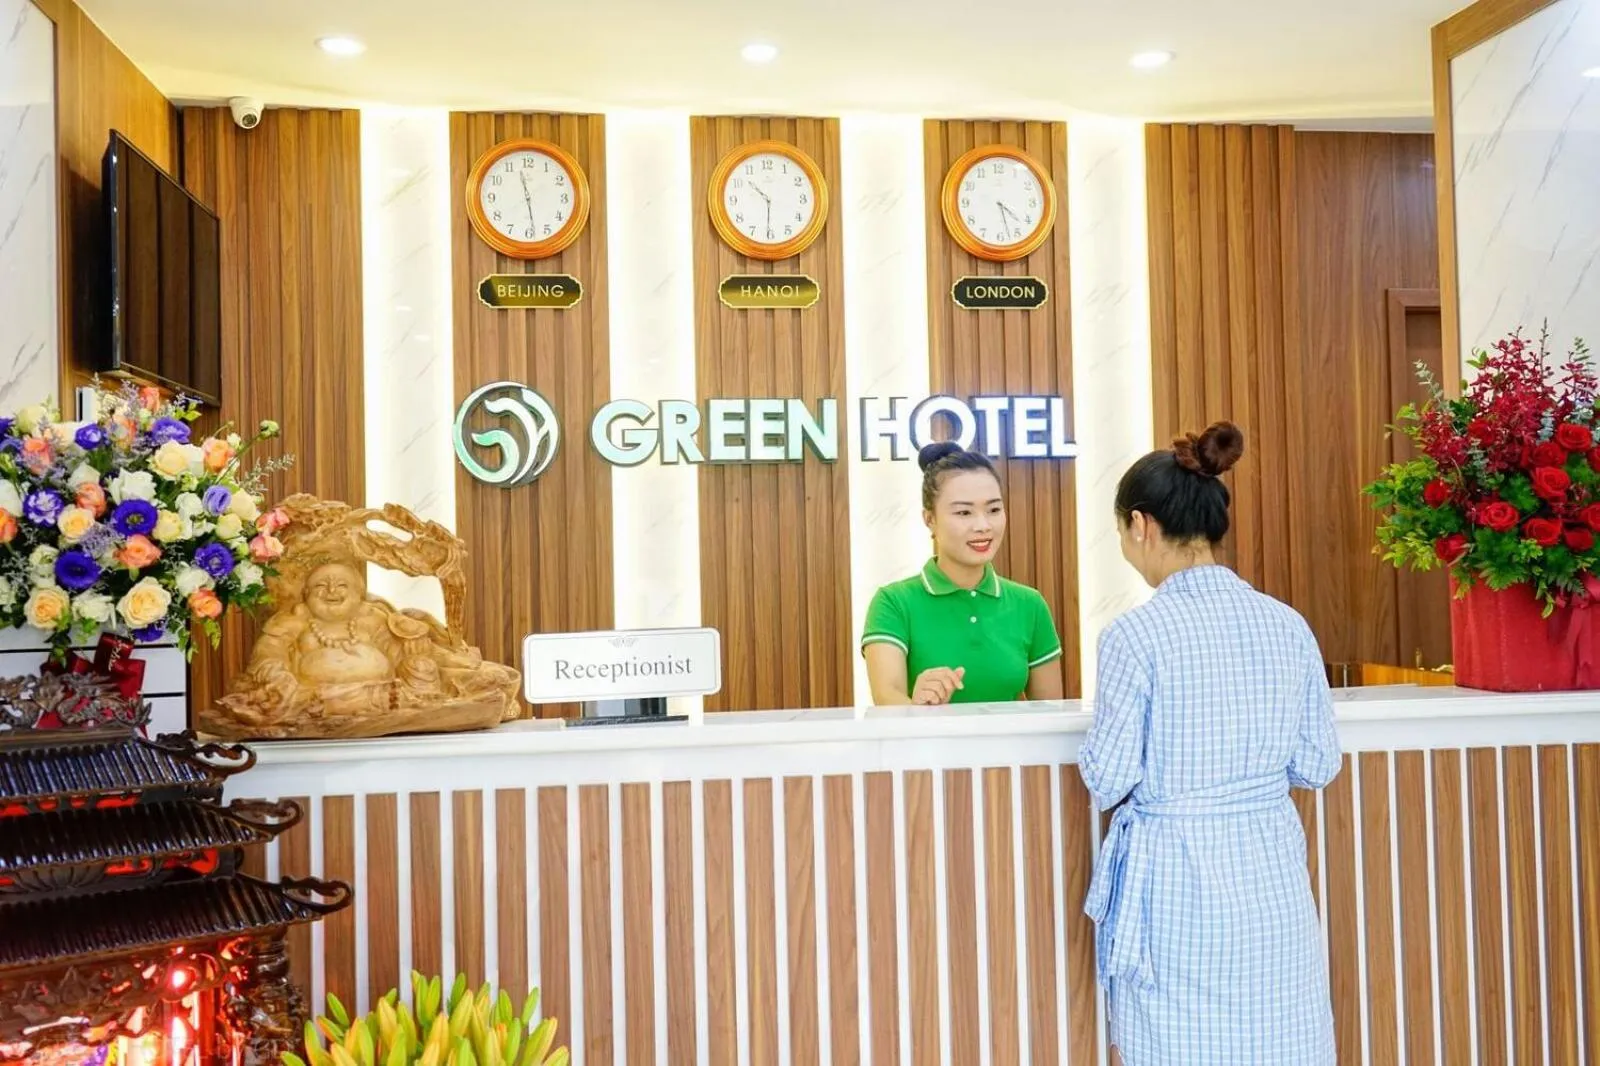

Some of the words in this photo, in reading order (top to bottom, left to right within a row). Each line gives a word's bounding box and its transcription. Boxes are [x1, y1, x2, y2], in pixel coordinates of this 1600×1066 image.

[504, 162, 513, 172] 11
[522, 158, 534, 168] 12
[544, 162, 548, 172] 1
[762, 160, 773, 170] 12
[745, 165, 753, 174] 11
[782, 164, 787, 174] 1
[977, 168, 986, 178] 11
[993, 164, 1004, 174] 12
[492, 176, 502, 186] 10
[555, 176, 564, 186] 2
[733, 178, 743, 188] 10
[794, 177, 802, 186] 2
[965, 181, 975, 191] 10
[488, 193, 495, 203] 9
[561, 193, 568, 203] 3
[729, 195, 737, 205] 9
[800, 194, 807, 204] 3
[962, 198, 970, 208] 9
[1029, 197, 1036, 208] 3
[494, 211, 502, 220] 8
[554, 211, 563, 221] 4
[736, 213, 744, 223] 8
[795, 212, 802, 221] 4
[968, 216, 975, 225] 8
[1024, 216, 1032, 224] 4
[507, 224, 514, 234] 7
[543, 225, 551, 234] 5
[749, 226, 756, 236] 7
[785, 226, 792, 235] 5
[980, 228, 987, 238] 7
[1014, 228, 1021, 238] 5
[997, 232, 1004, 242] 6
[497, 284, 564, 297] BEIJING
[741, 285, 799, 297] HANOI
[966, 286, 1035, 298] LONDON
[590, 397, 838, 466] GREEN
[860, 394, 1078, 462] HOTEL
[554, 655, 692, 682] Receptionist
